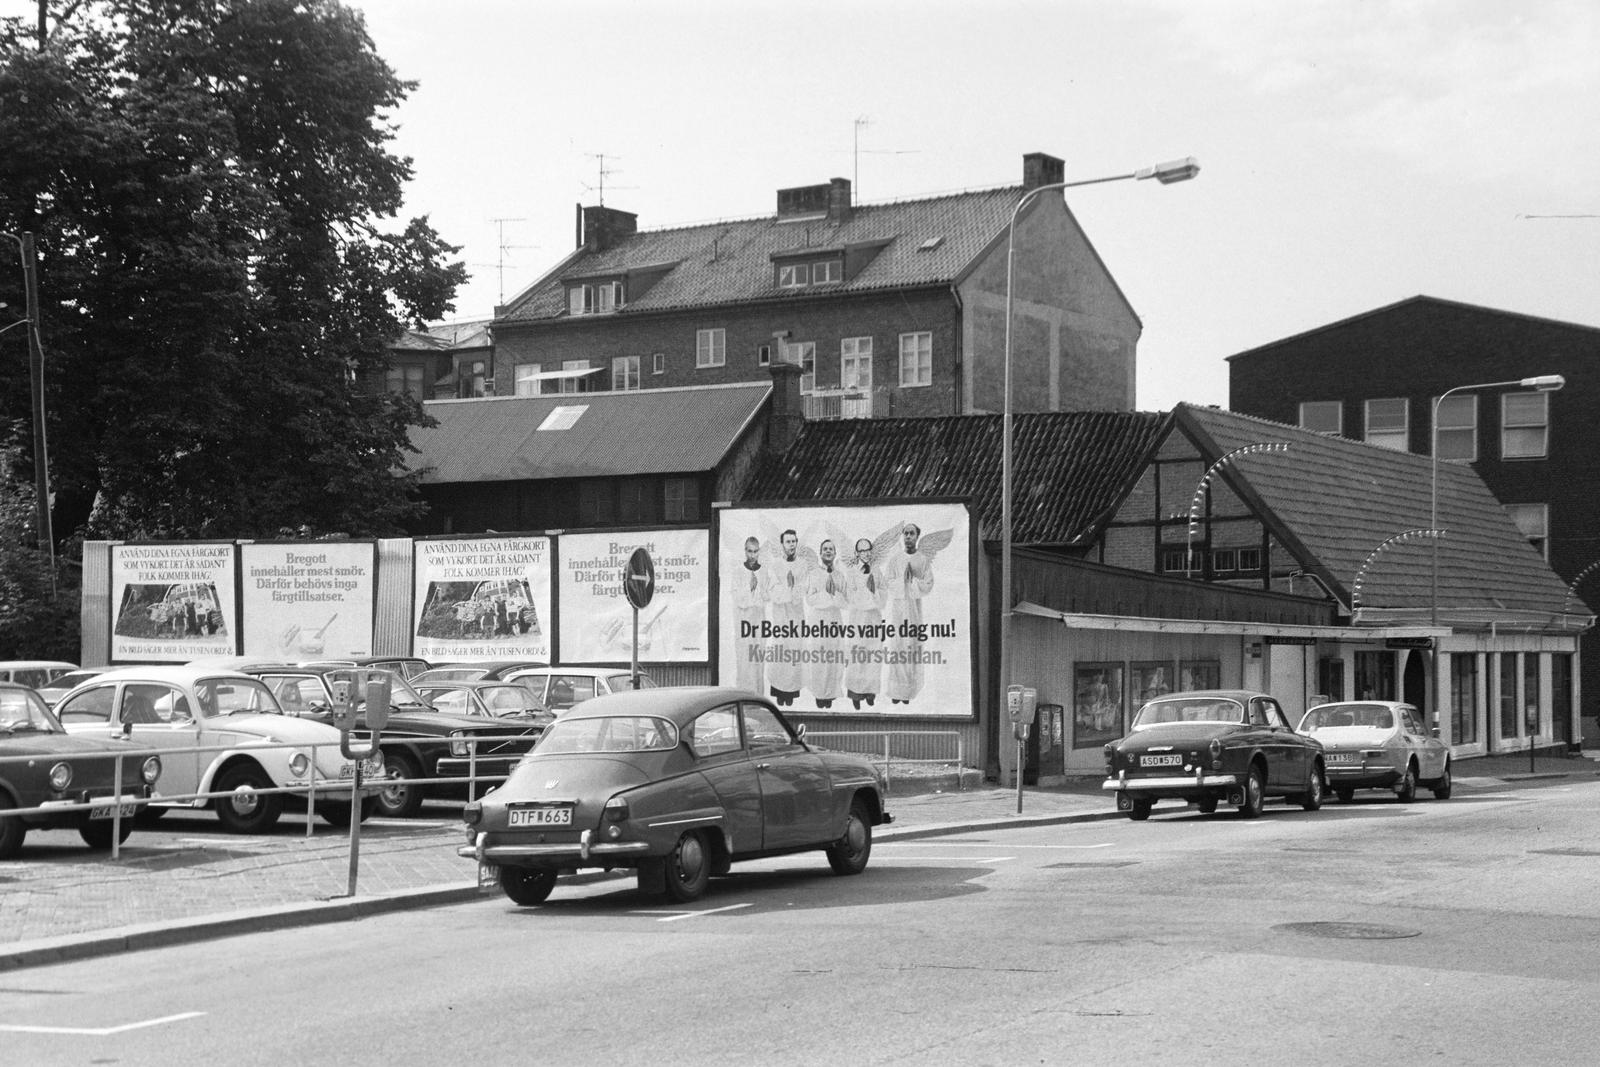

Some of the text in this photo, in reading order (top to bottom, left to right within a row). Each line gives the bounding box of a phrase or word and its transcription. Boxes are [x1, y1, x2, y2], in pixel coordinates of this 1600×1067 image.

[120, 547, 230, 558] ANVÄND DINA EGNA FÄRGKORT
[424, 540, 546, 554] ANVÄND DINA EGNA FÄRGKORT
[123, 560, 138, 569] SOM
[170, 560, 184, 569] DET
[185, 559, 196, 569] ÄR
[286, 552, 327, 567] Bregott
[428, 556, 444, 566] SOM
[480, 554, 496, 565] DET
[496, 553, 507, 565] ÄR
[568, 556, 631, 570] innehålle
[664, 554, 699, 567] smör.
[138, 572, 157, 581] FOLK
[158, 571, 190, 580] KOMMER
[250, 565, 366, 577] innehåller mest smör.
[444, 568, 463, 578] FOLK
[466, 567, 500, 577] KOMMER
[574, 570, 615, 583] Därför
[664, 568, 691, 583] inga
[256, 577, 358, 592] Därför behövs inga
[272, 590, 345, 604] färgtillsatser.
[740, 619, 956, 643] Dr Besk behövs varje dag nu!
[748, 644, 947, 668] Kvällsposten, förstasidan.
[1164, 756, 1181, 765] 570
[511, 809, 569, 825] DTF 663
